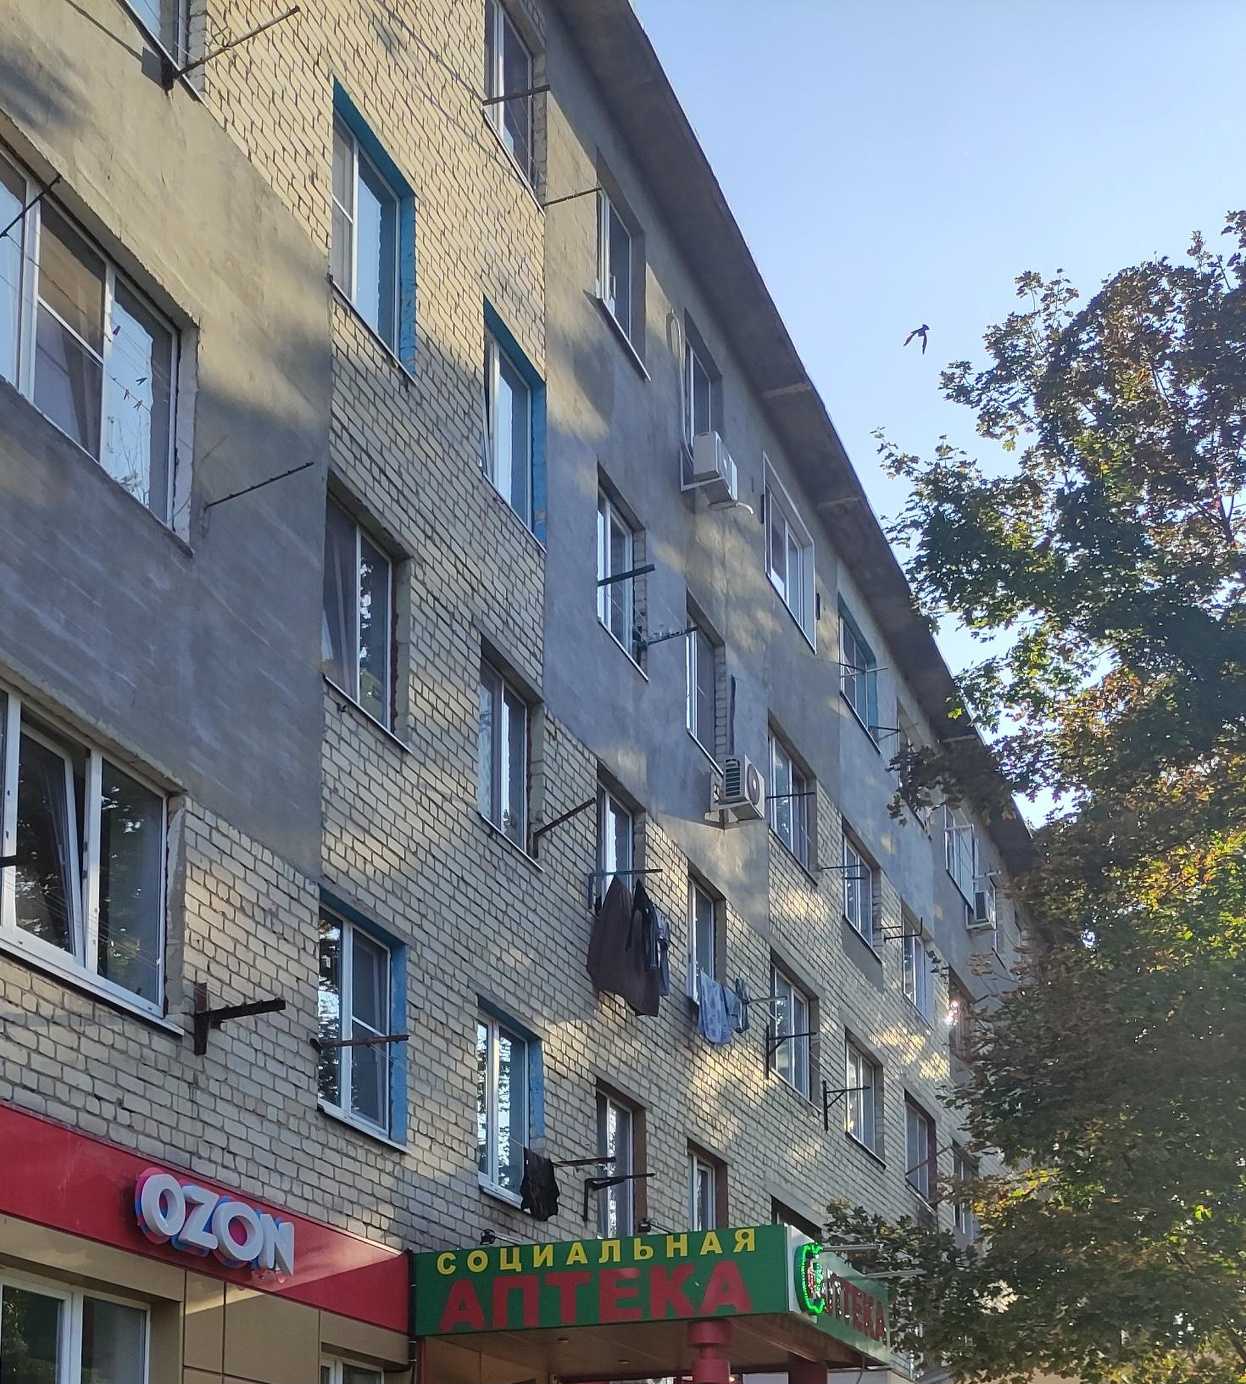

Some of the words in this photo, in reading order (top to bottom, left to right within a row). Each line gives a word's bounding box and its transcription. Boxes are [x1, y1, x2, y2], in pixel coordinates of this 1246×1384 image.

[136, 1169, 295, 1276] OZON
[436, 1228, 757, 1276] СОЦИАЛЬНАЯ
[439, 1260, 753, 1333] АПТЕКА
